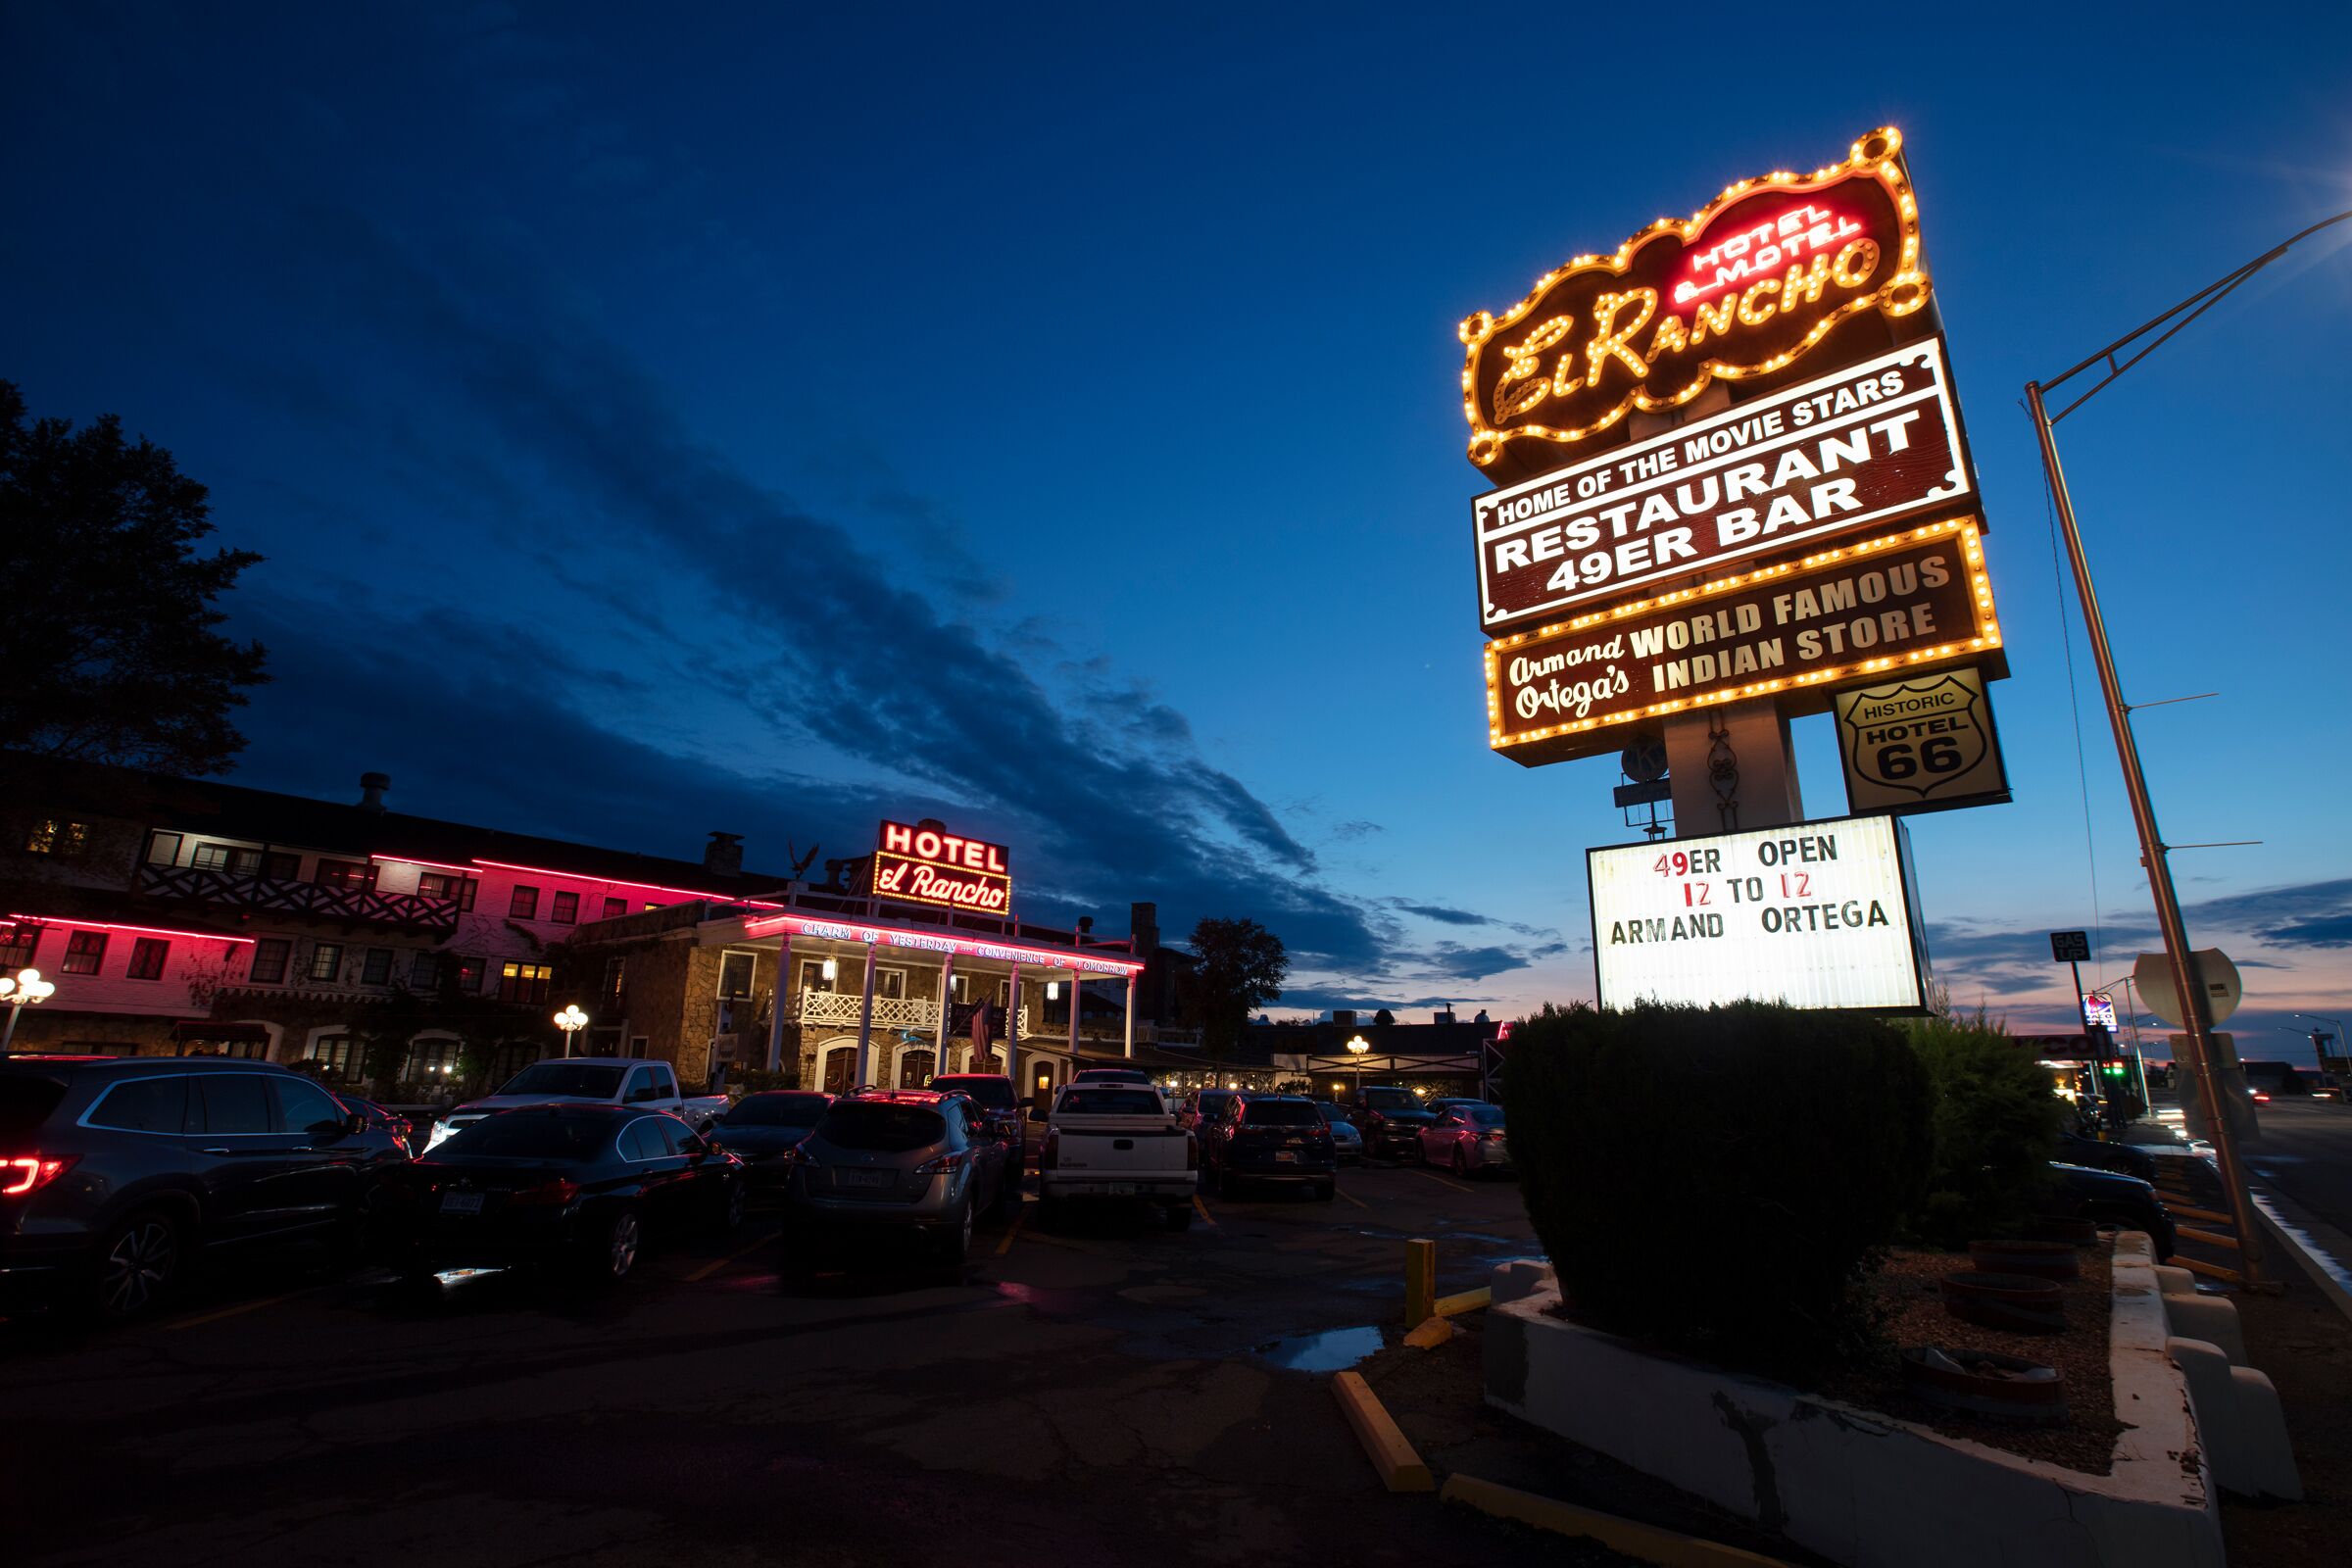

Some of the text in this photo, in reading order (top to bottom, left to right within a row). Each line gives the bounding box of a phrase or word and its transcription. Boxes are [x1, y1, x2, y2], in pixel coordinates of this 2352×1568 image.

[1673, 216, 1864, 305] & MOTEL
[1692, 202, 1834, 271] HOTEL
[1497, 370, 1905, 526] HOME OF THE MOVIE STARS
[1494, 409, 1922, 574] RESTAURANT
[1545, 476, 1865, 594] 49ER BAR
[1508, 555, 1951, 687] Armand WORLD FAMOUS
[1515, 602, 1937, 720] Ortega's INDIAN STORE
[1864, 692, 1955, 720] HISTORIC
[1866, 716, 1969, 746] HOTEL
[1876, 736, 1963, 780] 66
[885, 823, 1005, 873] HOTEL
[1652, 834, 1838, 878] 49ER OPEN
[909, 865, 1004, 907] Rancho
[1684, 871, 1813, 908] 12 TO 12
[1610, 900, 1890, 946] ARMAND ORTEGA
[2053, 934, 2085, 949] GAS
[803, 923, 1128, 976] CHARM OF YESTERDAY CONVENIENCE OF TOMORROW
[2059, 949, 2086, 959] UP
